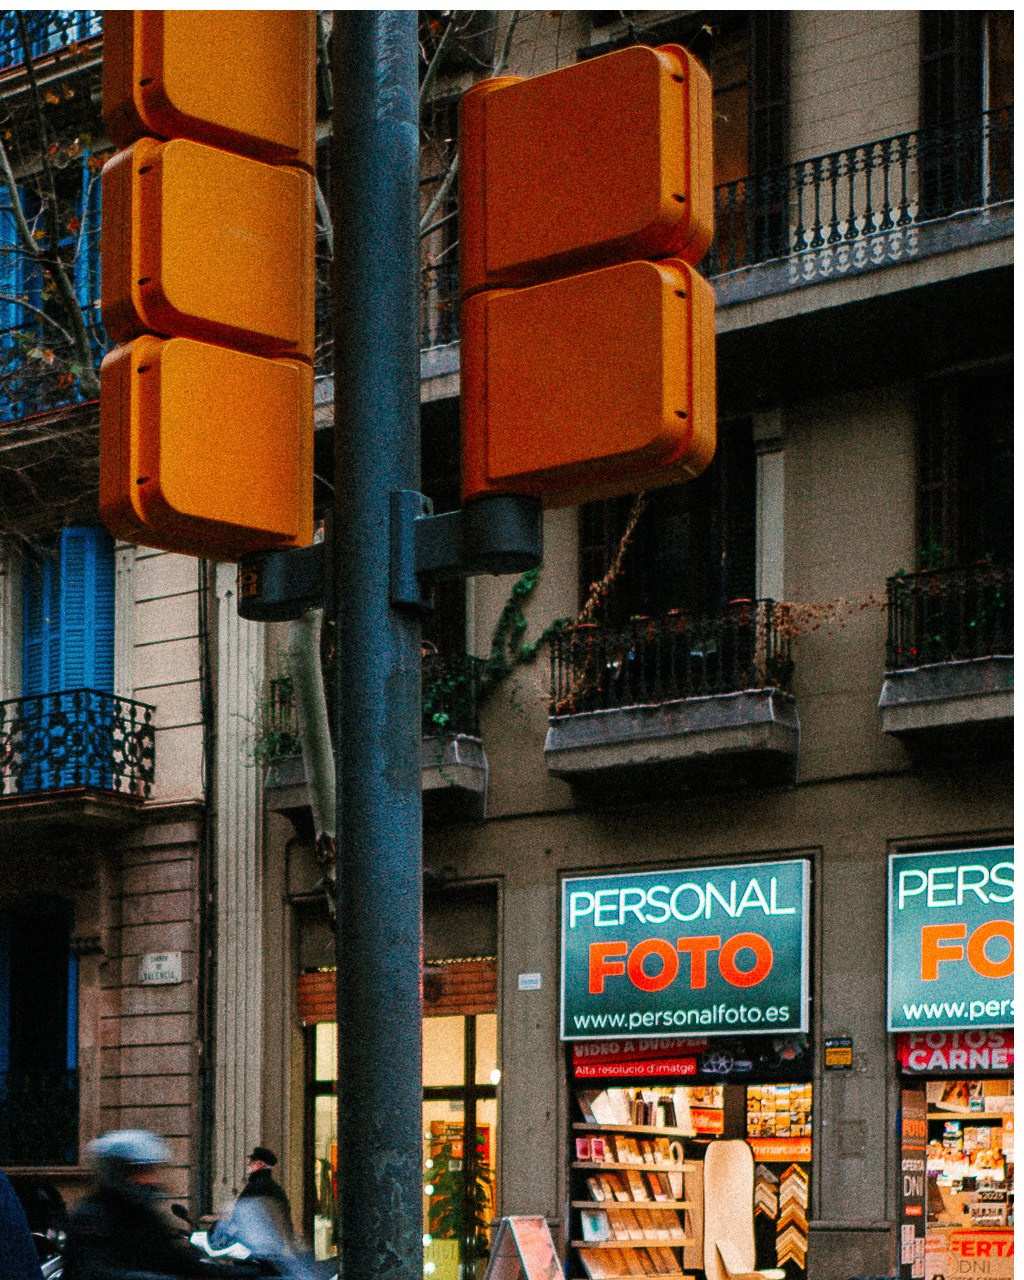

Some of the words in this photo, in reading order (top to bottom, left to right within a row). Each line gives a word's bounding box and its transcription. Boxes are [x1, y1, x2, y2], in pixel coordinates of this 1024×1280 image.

[898, 861, 1014, 910] PERS
[569, 876, 796, 929] PERSONAL
[588, 932, 774, 994] FOTO
[920, 919, 1014, 982] FO
[573, 1003, 790, 1030] www.personalfoto.es
[910, 1030, 1005, 1050] FOTOS
[575, 1066, 595, 1075] Alta
[903, 1175, 924, 1197] DNI
[959, 1260, 991, 1274] DNI
